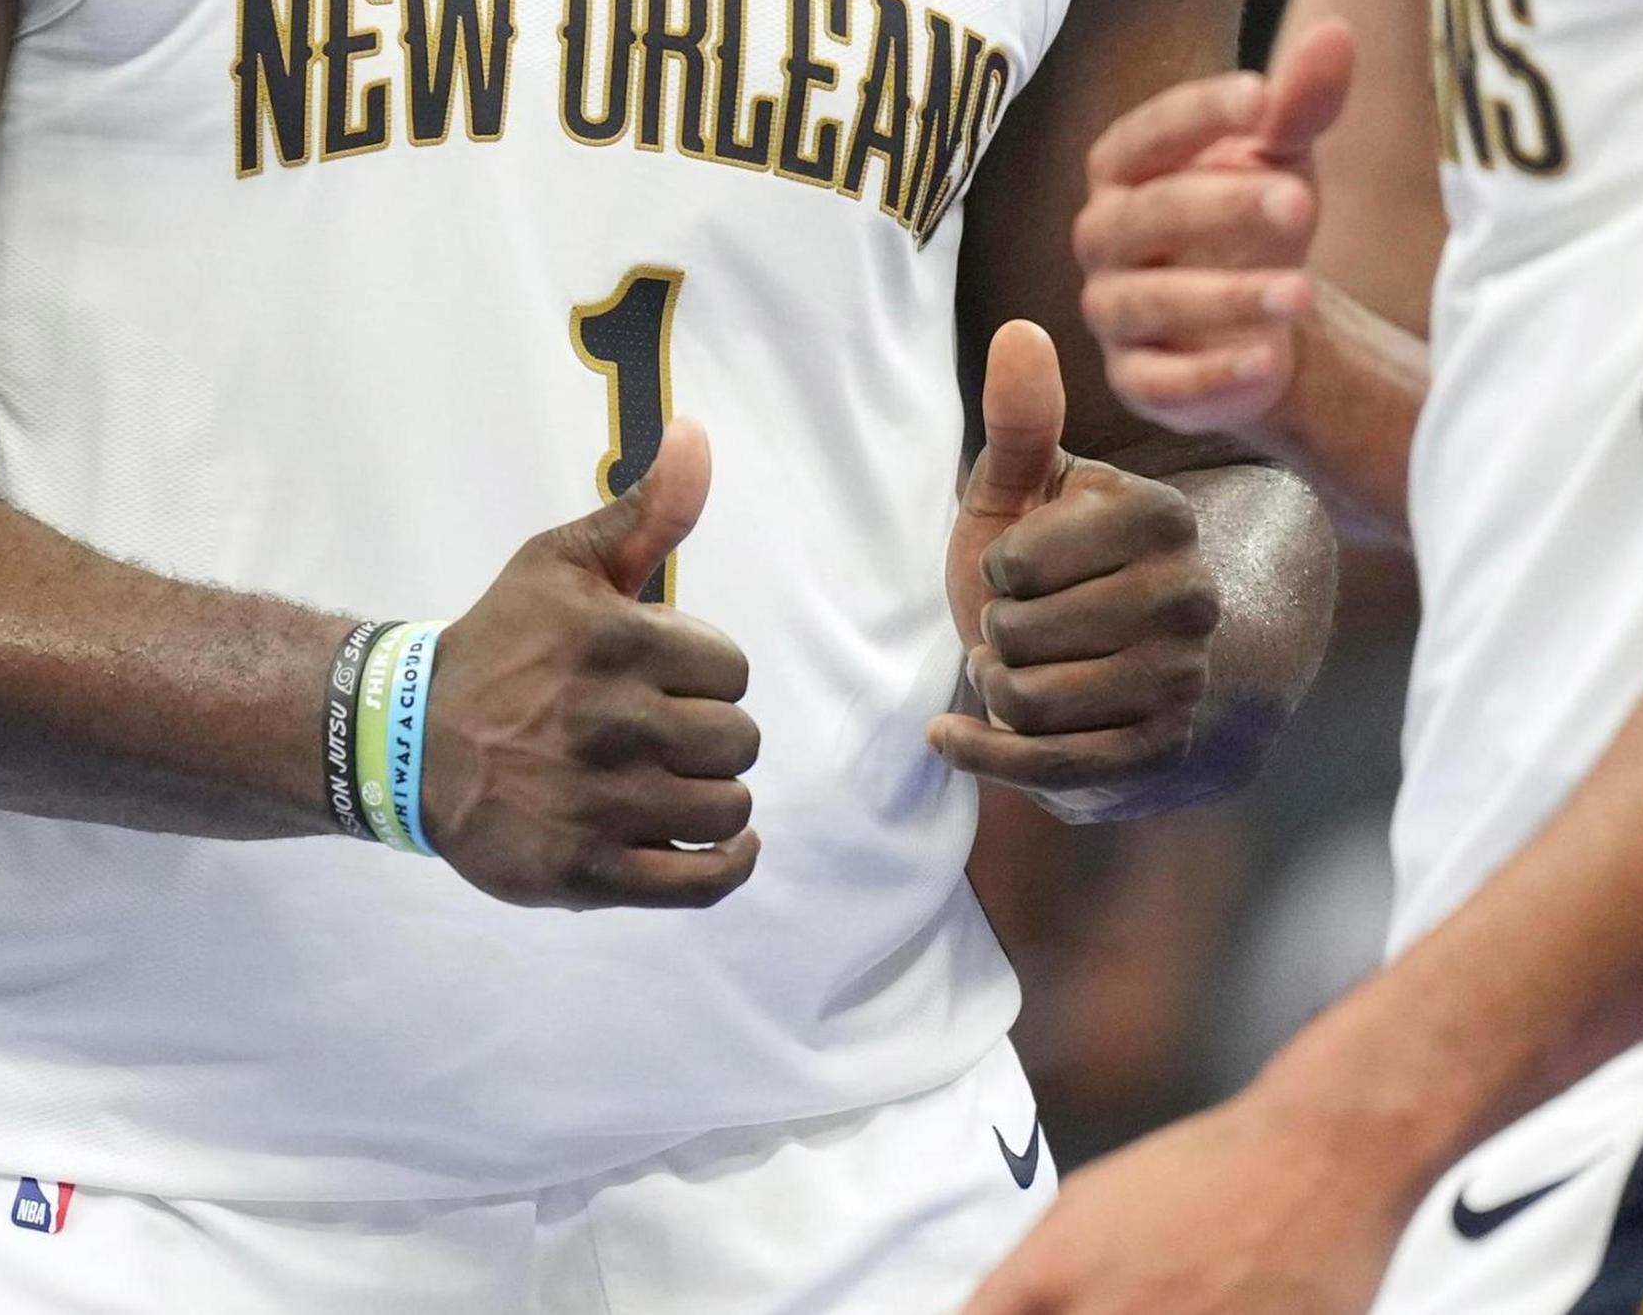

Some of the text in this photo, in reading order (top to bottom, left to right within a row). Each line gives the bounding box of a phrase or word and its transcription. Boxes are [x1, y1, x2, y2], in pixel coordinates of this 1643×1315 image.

[569, 263, 686, 608] 1
[328, 699, 349, 774] JUTSU
[398, 715, 414, 732] A
[394, 736, 412, 785] WAS
[16, 1198, 47, 1226] NBA
